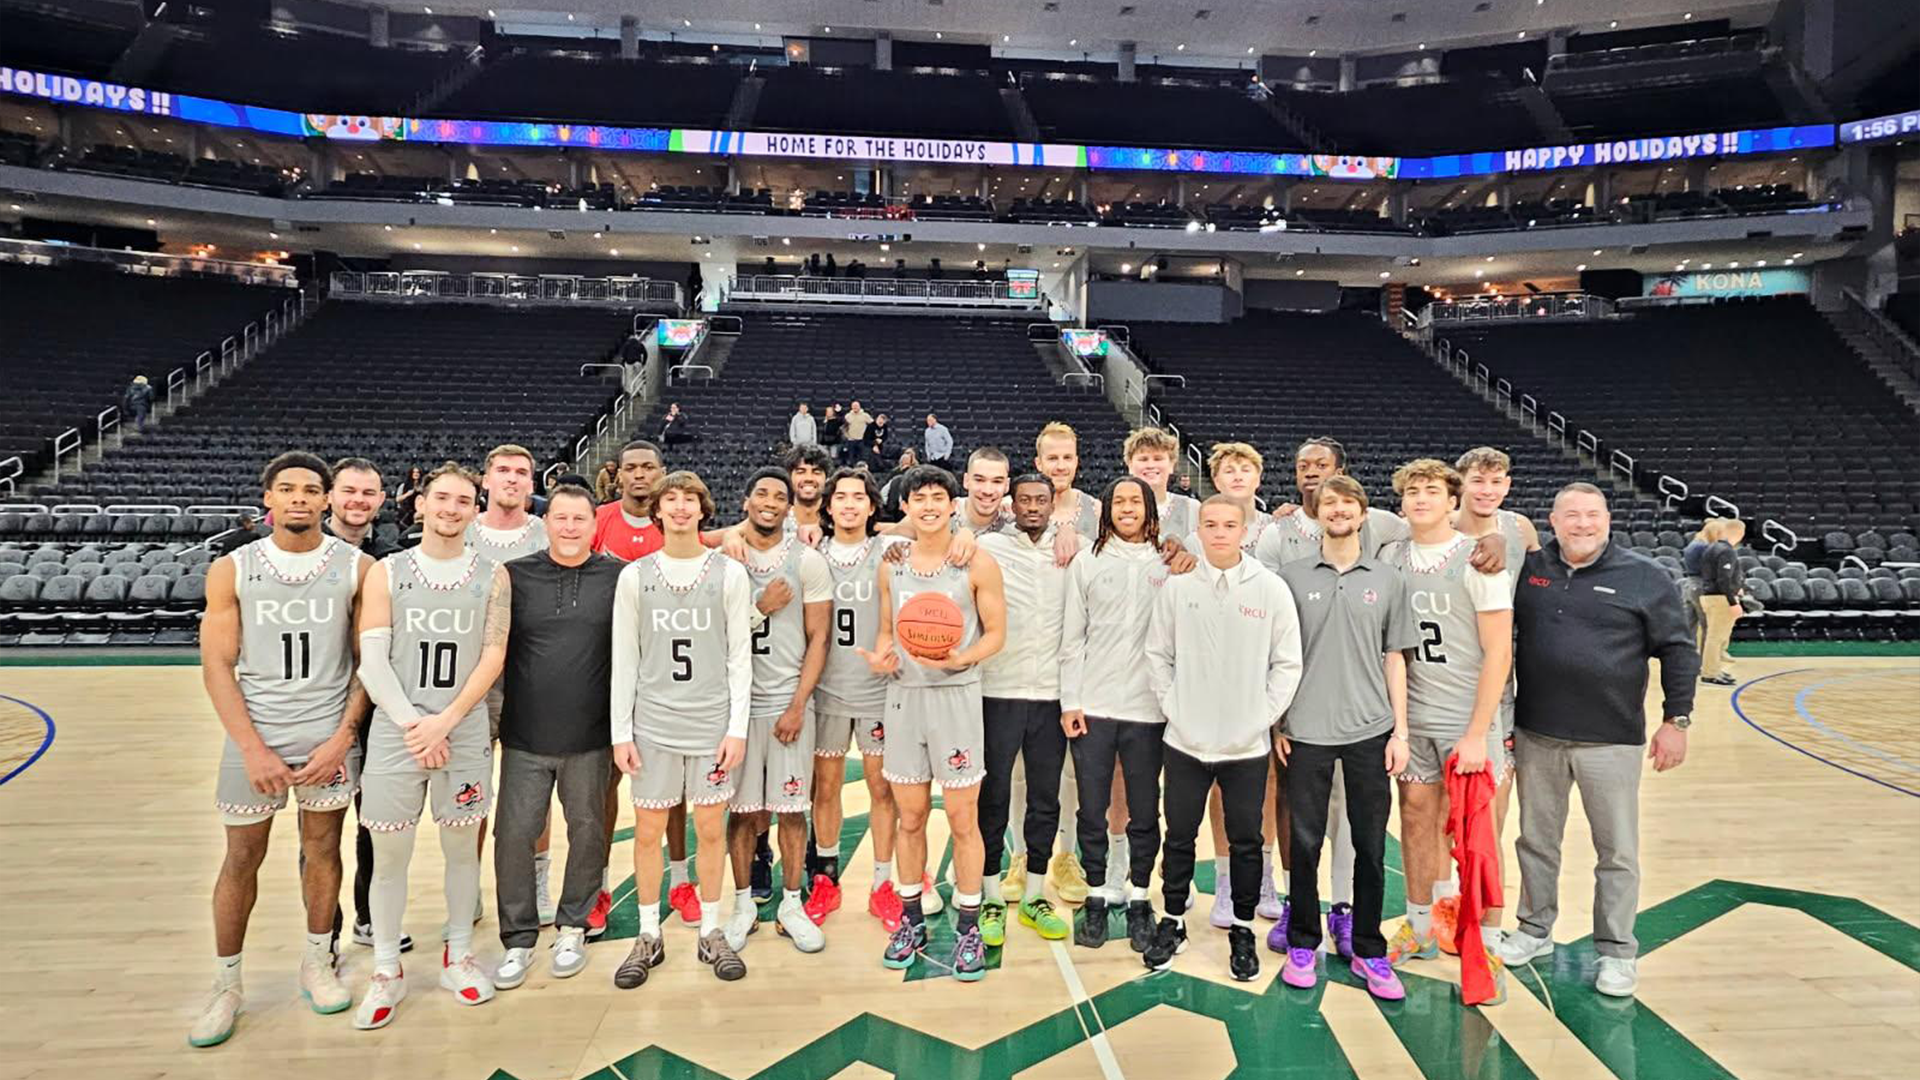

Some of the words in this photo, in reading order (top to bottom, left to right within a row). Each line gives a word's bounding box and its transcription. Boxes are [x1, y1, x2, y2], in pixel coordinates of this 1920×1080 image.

[1851, 119, 1898, 140] 1:56
[1902, 113, 1920, 132] P
[767, 136, 816, 154] HOME
[825, 138, 857, 156] FOR
[865, 140, 896, 158] THE
[904, 141, 986, 161] HOLIDAYS
[1505, 144, 1585, 171] HAPPY
[1595, 133, 1717, 164] HOLIDAYS
[1696, 272, 1763, 290] KONA
[836, 580, 873, 602] CU
[1411, 590, 1451, 615] CU
[255, 598, 334, 625] RCU
[405, 607, 475, 635] RCU
[652, 607, 711, 632] RCU
[1243, 606, 1268, 619] RCU
[751, 615, 771, 656] 2
[836, 607, 856, 647] 9
[280, 630, 312, 681] 11
[418, 639, 459, 690] 10
[671, 637, 693, 683] 5
